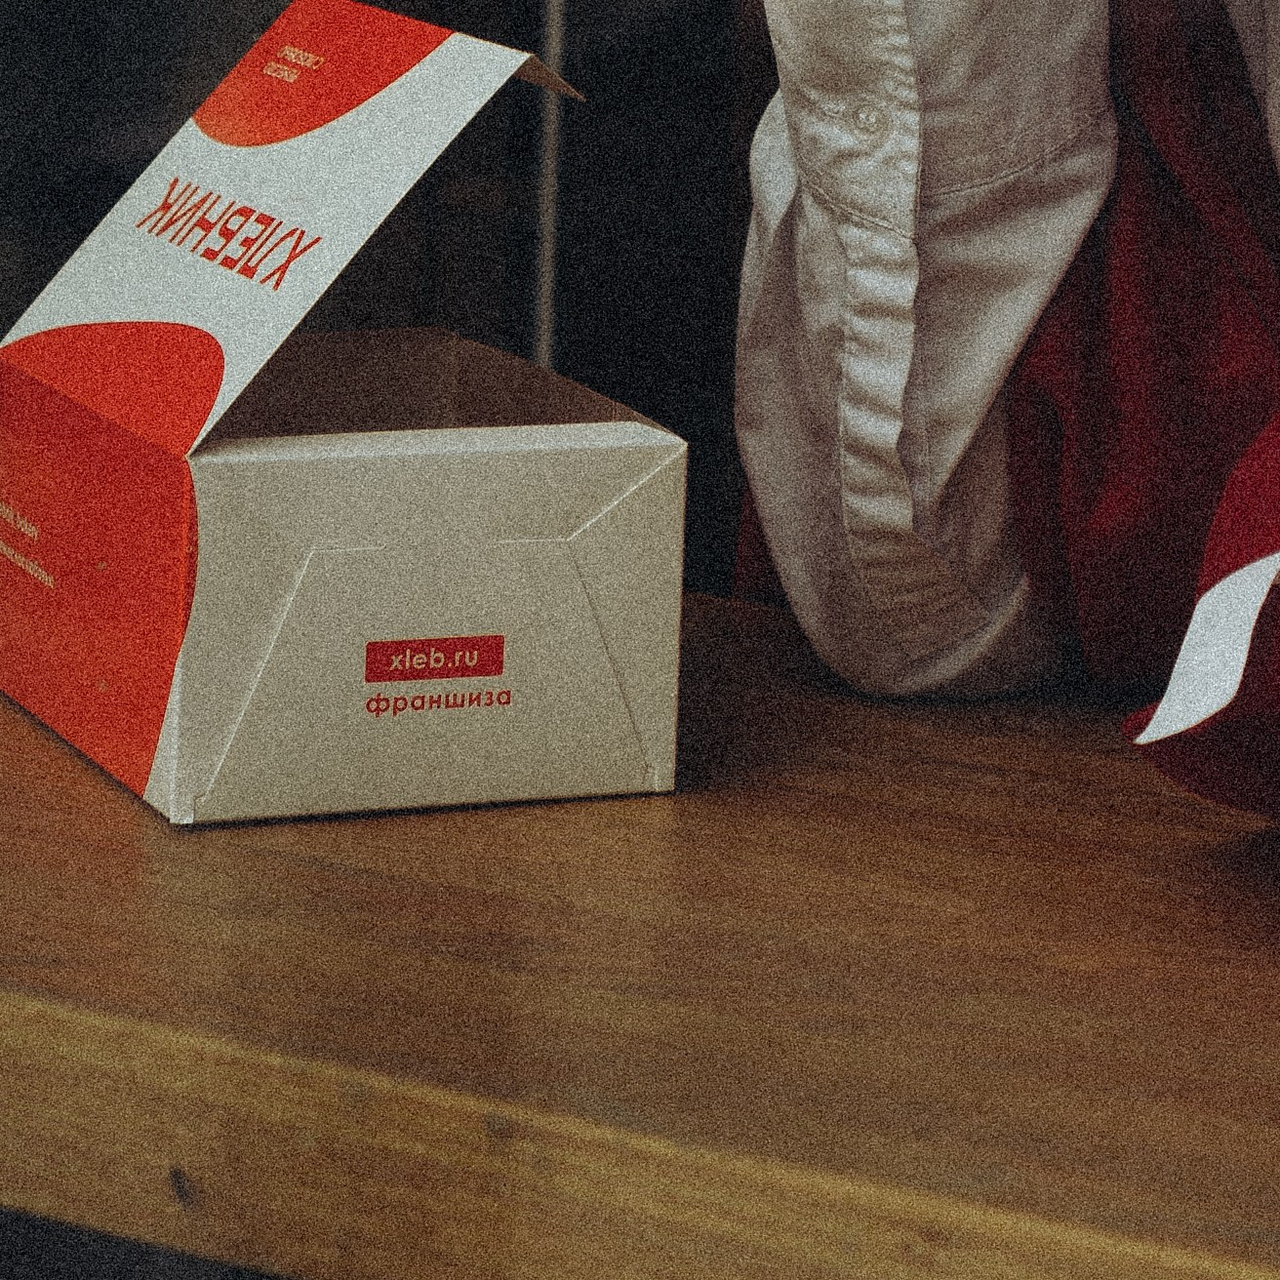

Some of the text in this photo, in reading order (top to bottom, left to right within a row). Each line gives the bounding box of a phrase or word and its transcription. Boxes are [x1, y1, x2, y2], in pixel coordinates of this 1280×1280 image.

[135, 177, 322, 292] ХЛЕБНИК
[389, 647, 479, 671] xleb.ru
[365, 688, 512, 718] франшиза
